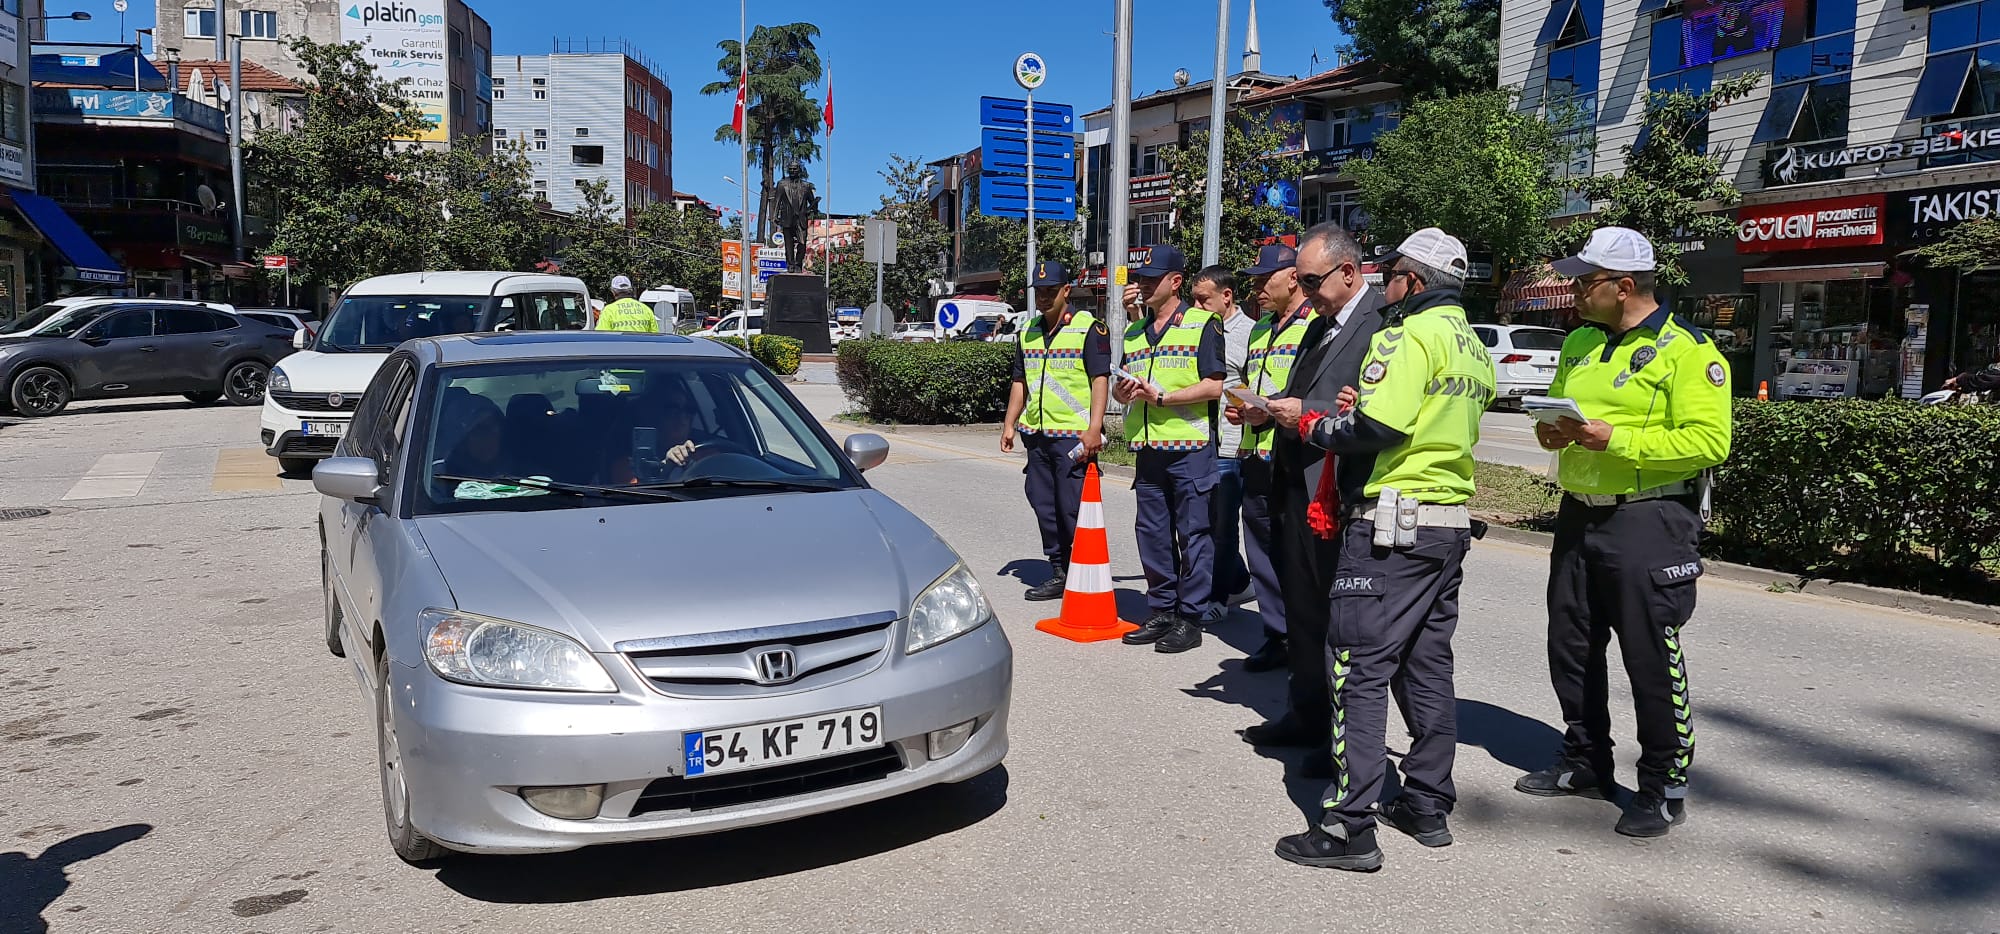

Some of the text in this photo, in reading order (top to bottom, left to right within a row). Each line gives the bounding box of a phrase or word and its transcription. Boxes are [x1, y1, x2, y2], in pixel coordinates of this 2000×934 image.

[363, 1, 443, 27] platin gsm
[401, 38, 443, 49] Garantili
[371, 48, 443, 60] Teknik Servis
[417, 77, 443, 87] Cihaz
[1737, 213, 1814, 242] GÜLEN
[1815, 222, 1877, 239] PARFÜMERİ
[309, 424, 342, 433] 34 CDM
[688, 711, 878, 768] TR 54 KF 719
